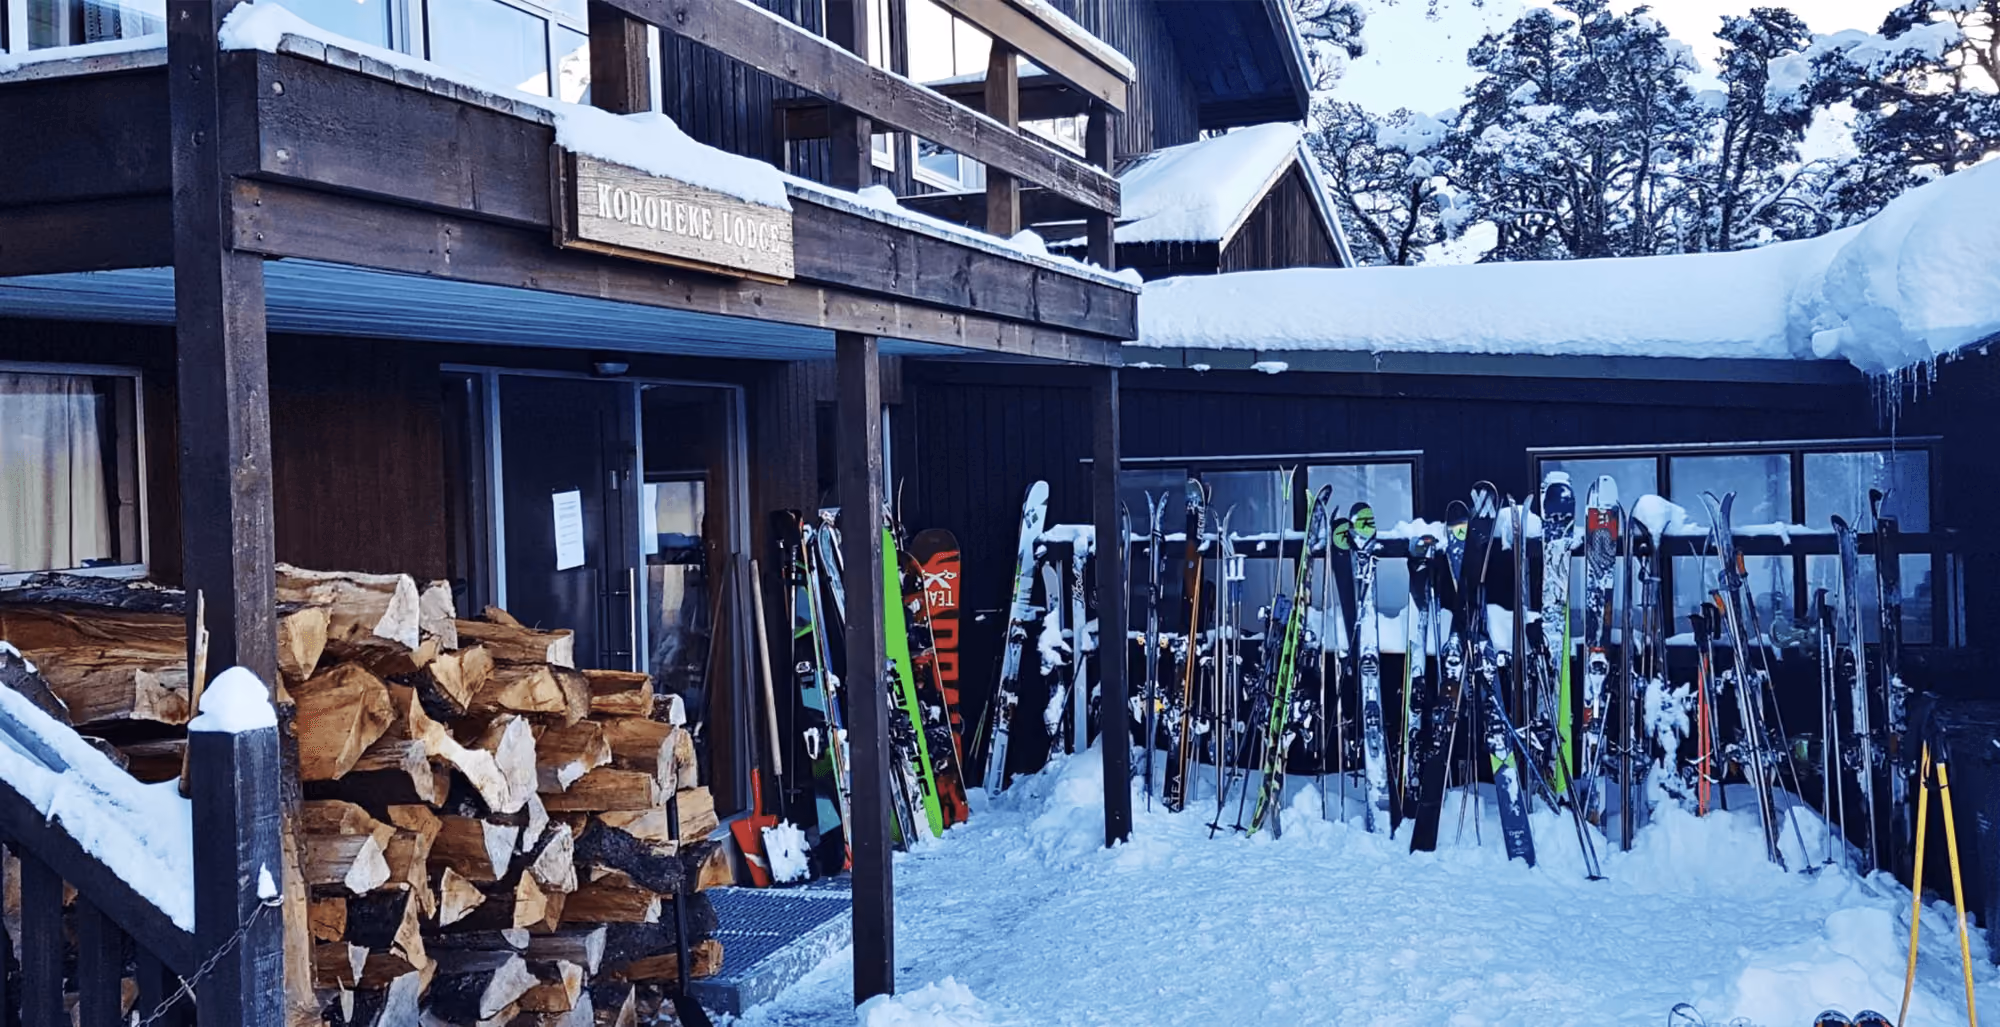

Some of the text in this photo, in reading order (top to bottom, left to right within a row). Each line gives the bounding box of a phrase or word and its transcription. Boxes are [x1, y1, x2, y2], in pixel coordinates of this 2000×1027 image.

[597, 183, 781, 253] KOROHEKE LODGE
[924, 590, 956, 607] TEA
